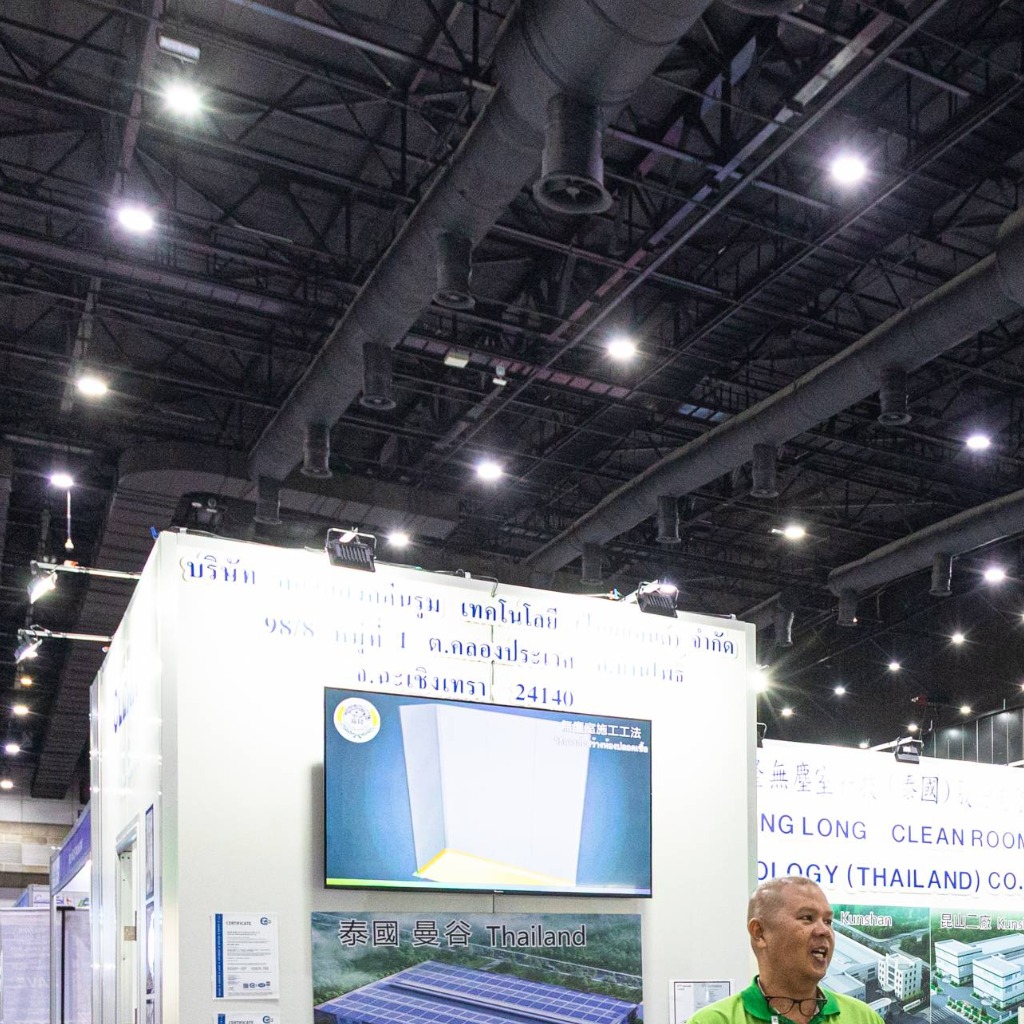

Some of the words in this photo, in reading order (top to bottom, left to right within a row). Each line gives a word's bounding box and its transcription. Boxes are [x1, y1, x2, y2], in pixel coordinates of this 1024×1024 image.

[460, 598, 558, 630] เทคโนโลยี
[514, 683, 575, 707] 24140
[802, 816, 867, 840] LONG
[891, 823, 965, 847] CLEAN
[847, 863, 980, 893] (THAILAND)
[338, 918, 400, 947] 泰國
[412, 919, 473, 948] 曼谷
[486, 924, 588, 948] Thailand
[839, 910, 893, 927] Kunshan
